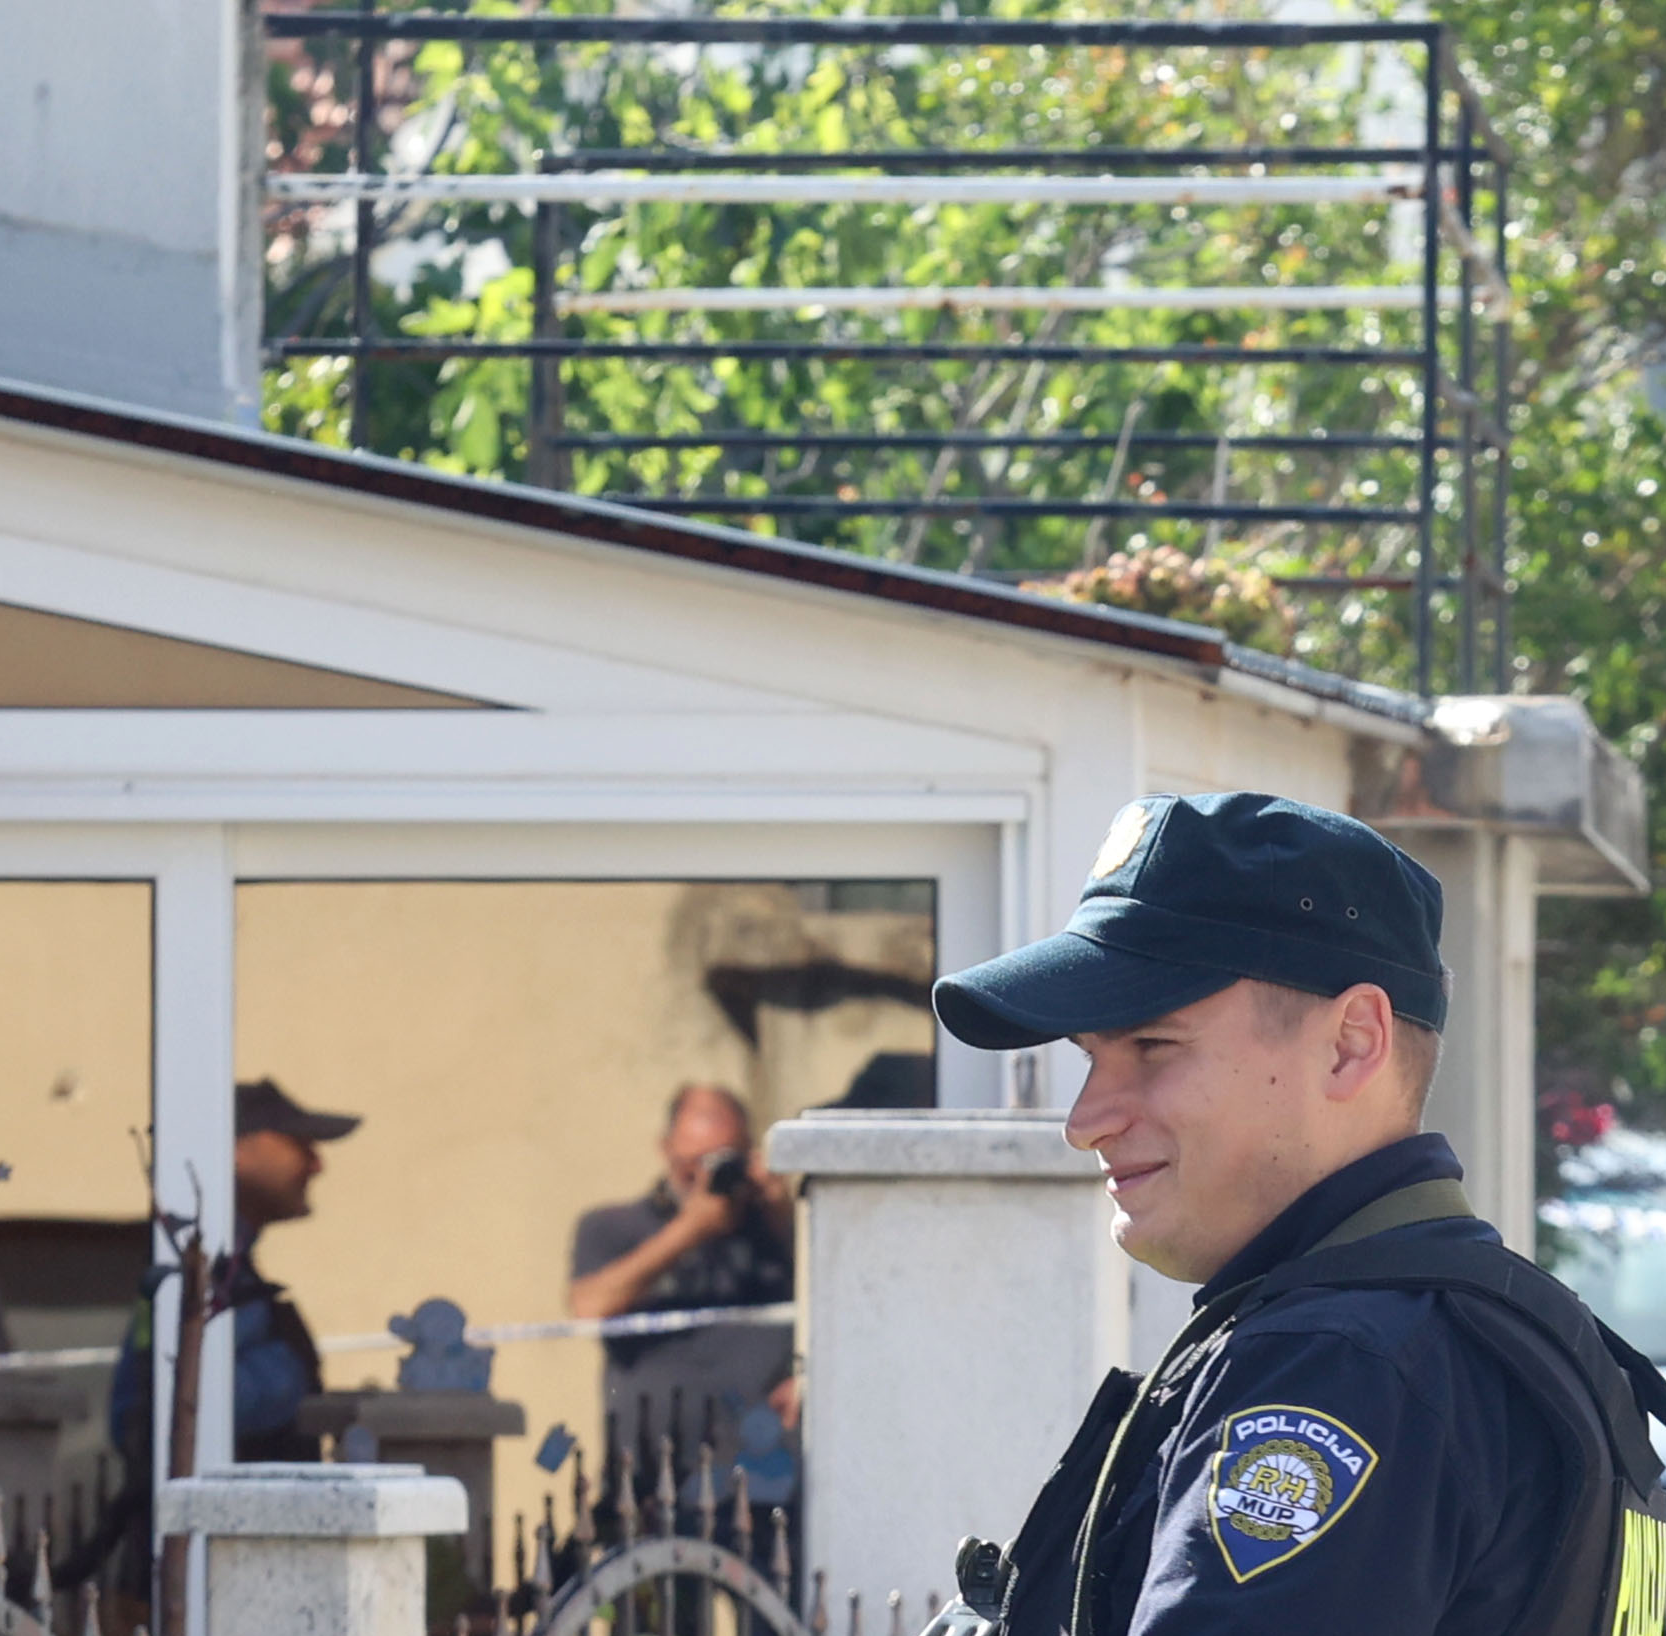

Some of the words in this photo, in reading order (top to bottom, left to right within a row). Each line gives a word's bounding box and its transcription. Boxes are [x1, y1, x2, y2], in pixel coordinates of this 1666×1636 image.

[1235, 1415, 1364, 1476] POLICIJA
[1249, 1464, 1308, 1502] RH
[1237, 1496, 1295, 1521] MUP
